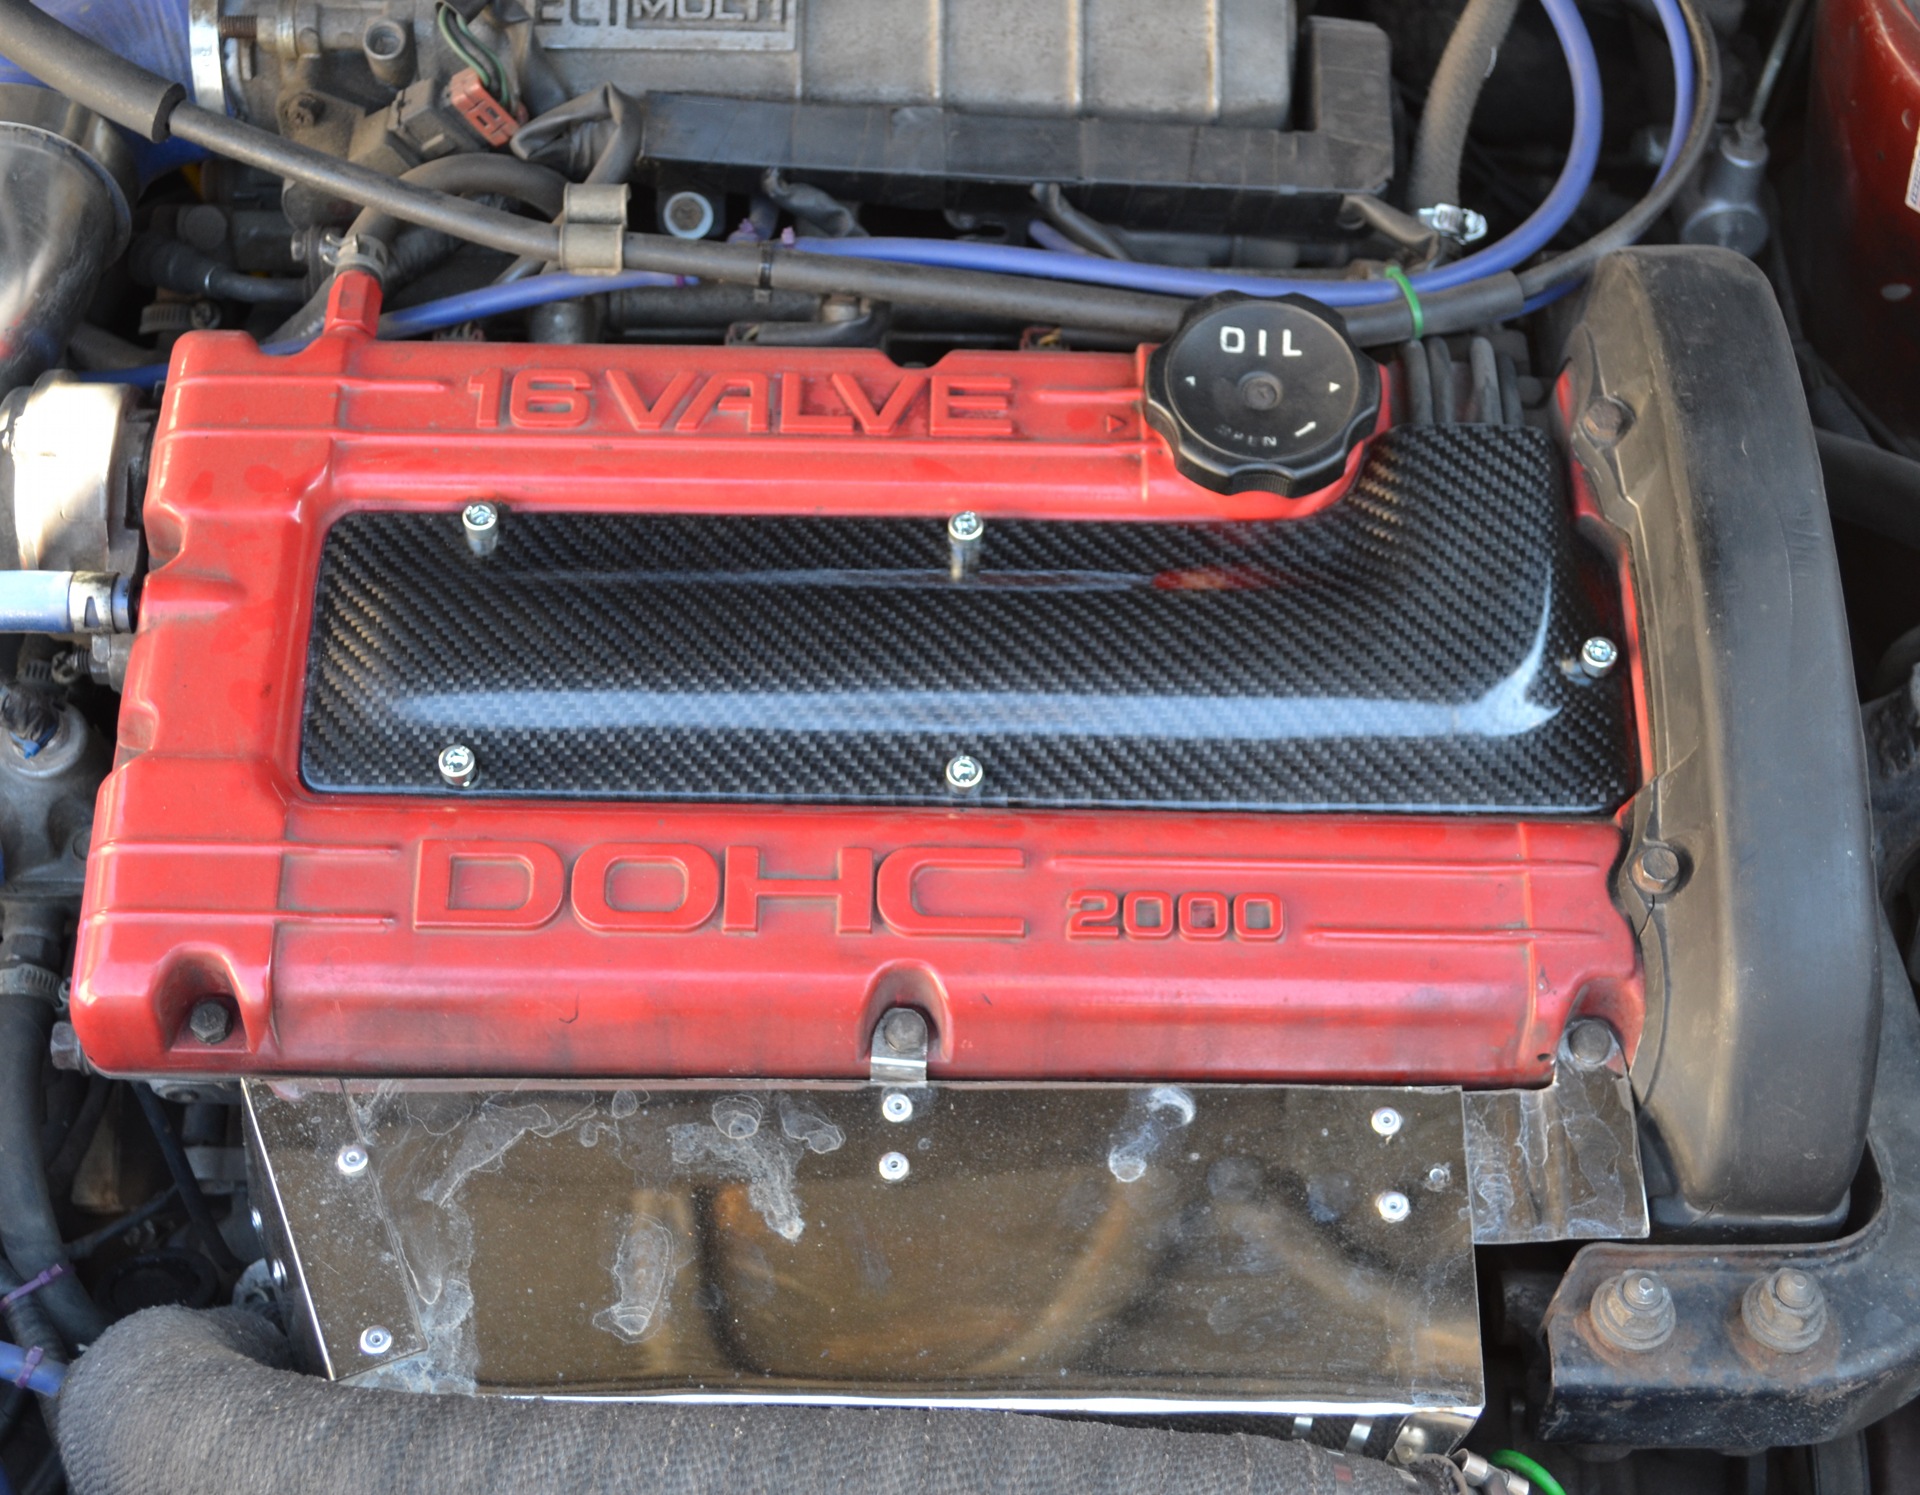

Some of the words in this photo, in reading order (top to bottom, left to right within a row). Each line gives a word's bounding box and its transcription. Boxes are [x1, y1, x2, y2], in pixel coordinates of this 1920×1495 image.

[1219, 325, 1303, 357] OIL
[412, 838, 1026, 938] DOHC
[1065, 889, 1284, 943] 2000
